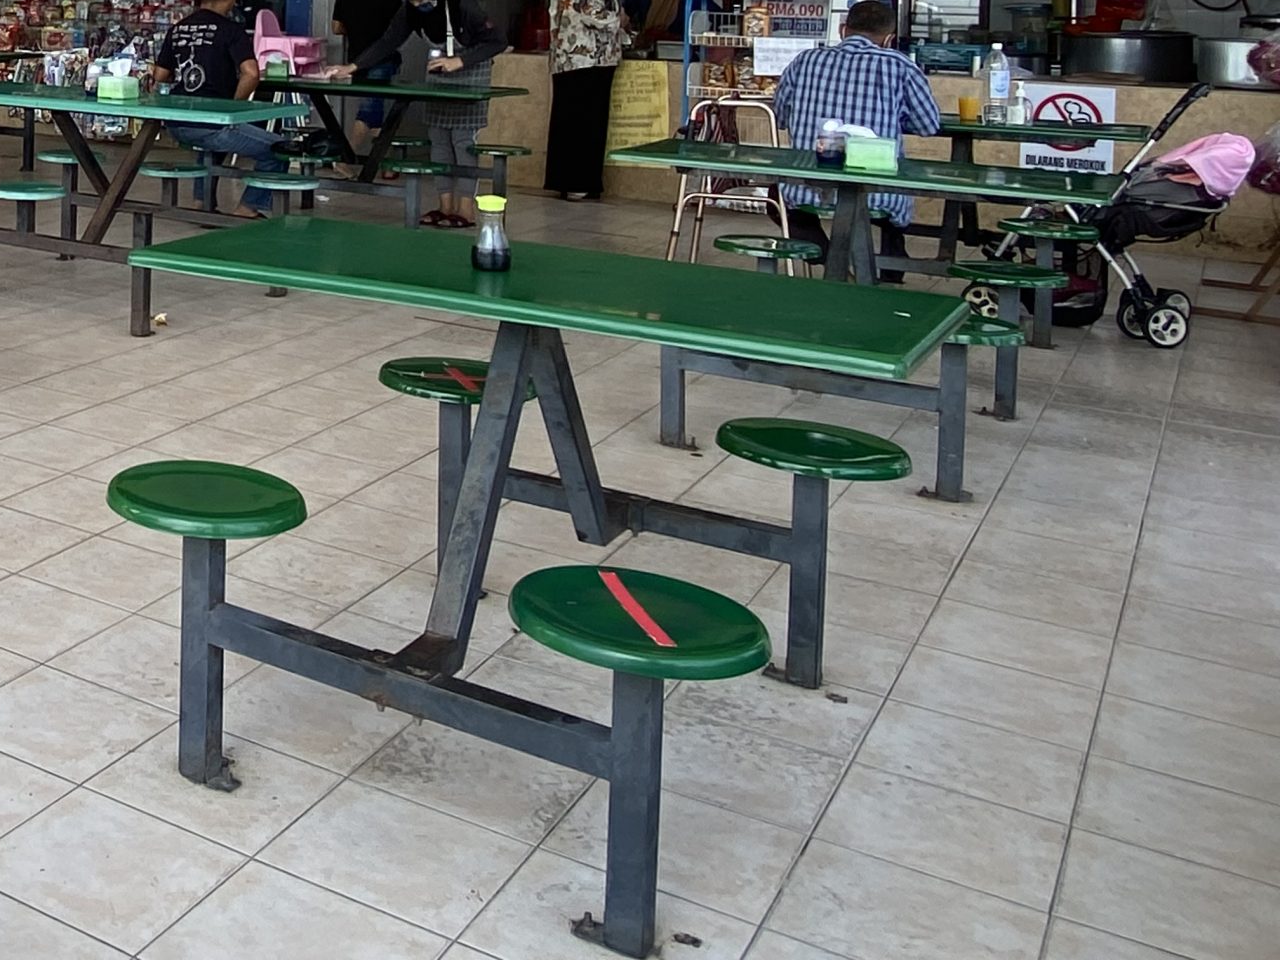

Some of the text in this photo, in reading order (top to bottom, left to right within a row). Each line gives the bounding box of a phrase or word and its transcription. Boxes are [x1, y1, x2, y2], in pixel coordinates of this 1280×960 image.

[767, 2, 824, 17] RM6.090
[1025, 154, 1106, 171] DILARANG MEROKOK
